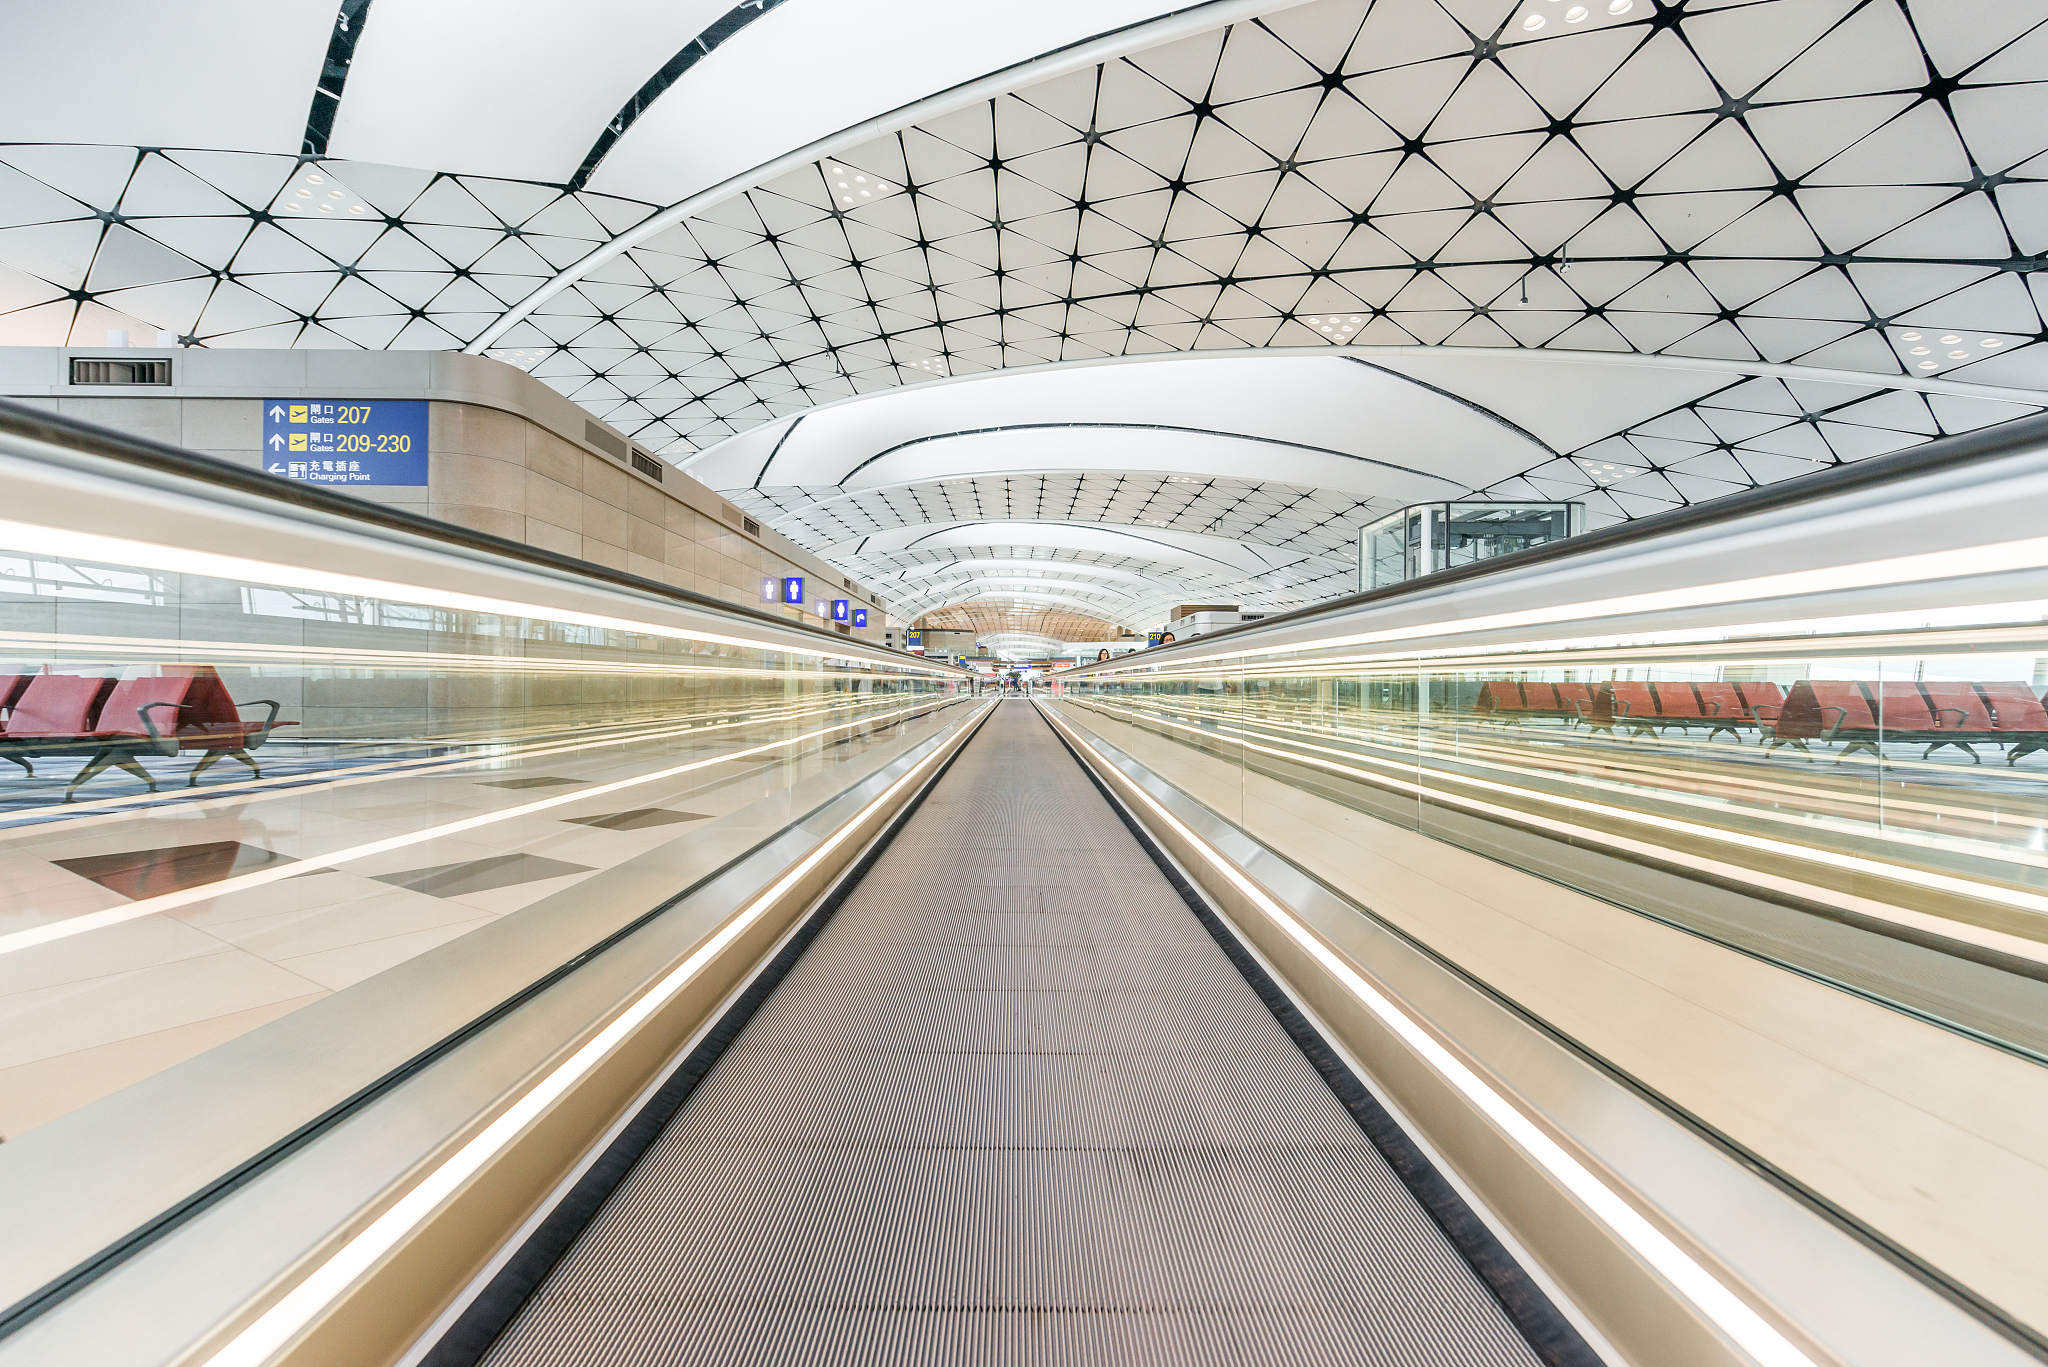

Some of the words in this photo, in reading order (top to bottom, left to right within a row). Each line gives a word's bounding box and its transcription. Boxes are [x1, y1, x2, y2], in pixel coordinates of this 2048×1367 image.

[310, 404, 334, 415] 閘口
[310, 416, 335, 424] Gates
[337, 406, 371, 424] 207
[309, 432, 333, 443] 閘口
[309, 444, 334, 452] Gates
[336, 434, 411, 453] 209-230
[309, 460, 360, 472] 充電插座
[309, 472, 347, 482] Charging
[349, 473, 371, 481] Point
